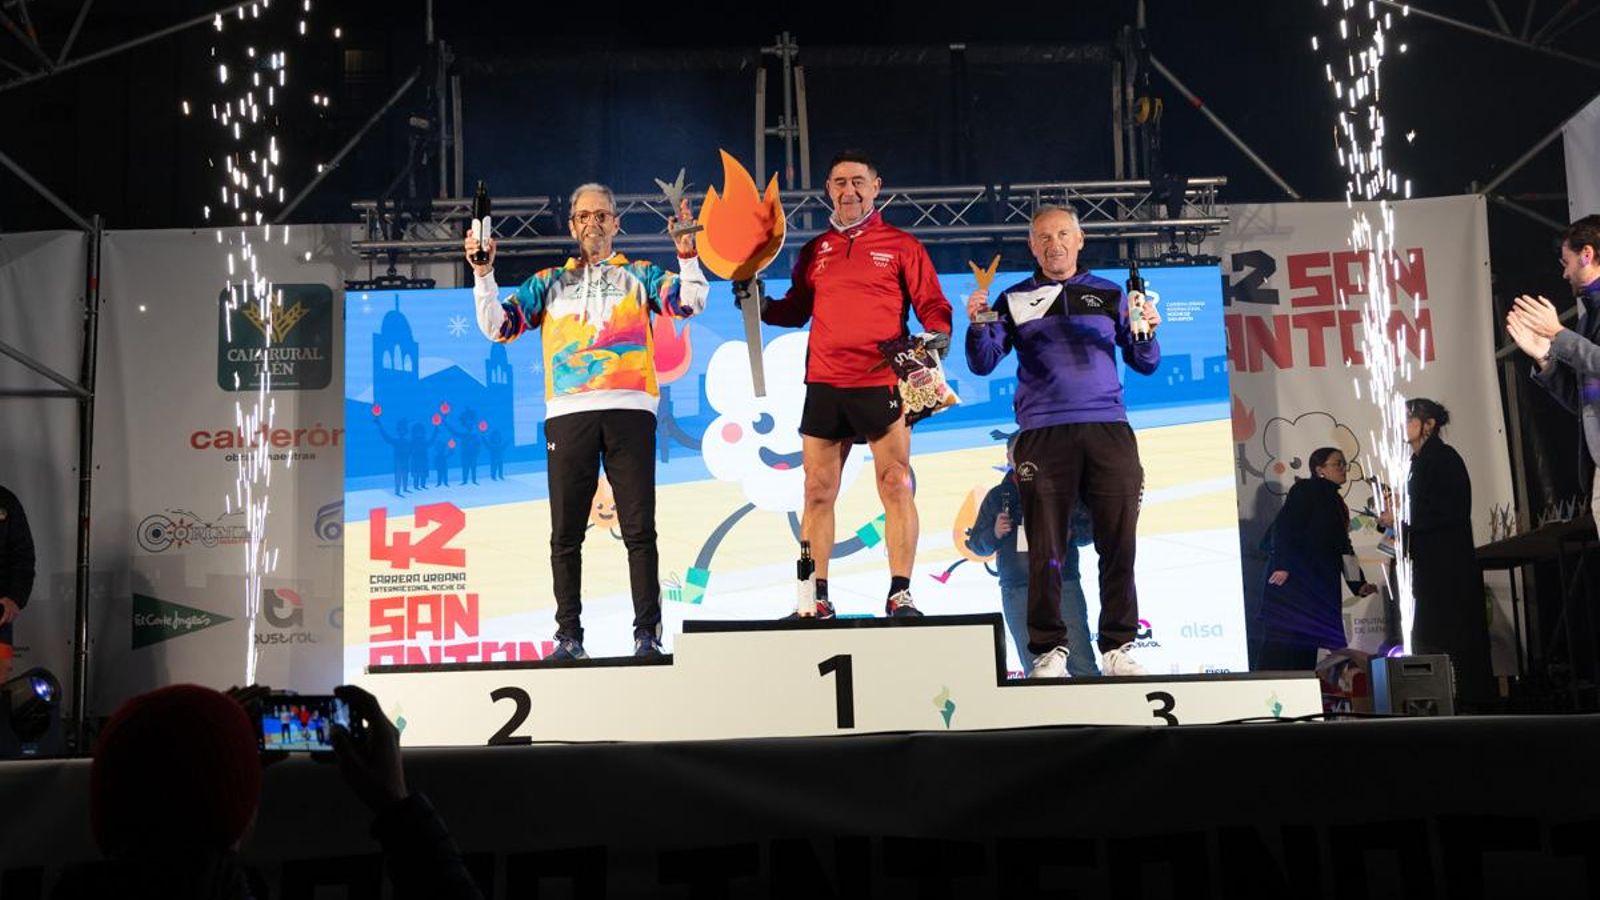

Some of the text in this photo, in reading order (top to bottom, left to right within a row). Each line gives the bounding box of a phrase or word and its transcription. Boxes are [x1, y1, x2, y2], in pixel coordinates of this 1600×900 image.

[1223, 248, 1428, 308] 2 SAN
[227, 347, 321, 361] CAJA RURAL
[369, 501, 466, 569] 42
[369, 571, 466, 585] CARRERA URBANA
[369, 583, 466, 593] INTERNACIONAL NOCHE DE
[143, 614, 172, 626] Corte
[369, 593, 479, 643] SAN
[1180, 622, 1223, 639] alsa
[818, 654, 855, 729] 1
[1145, 691, 1179, 727] 3
[488, 686, 532, 746] 2
